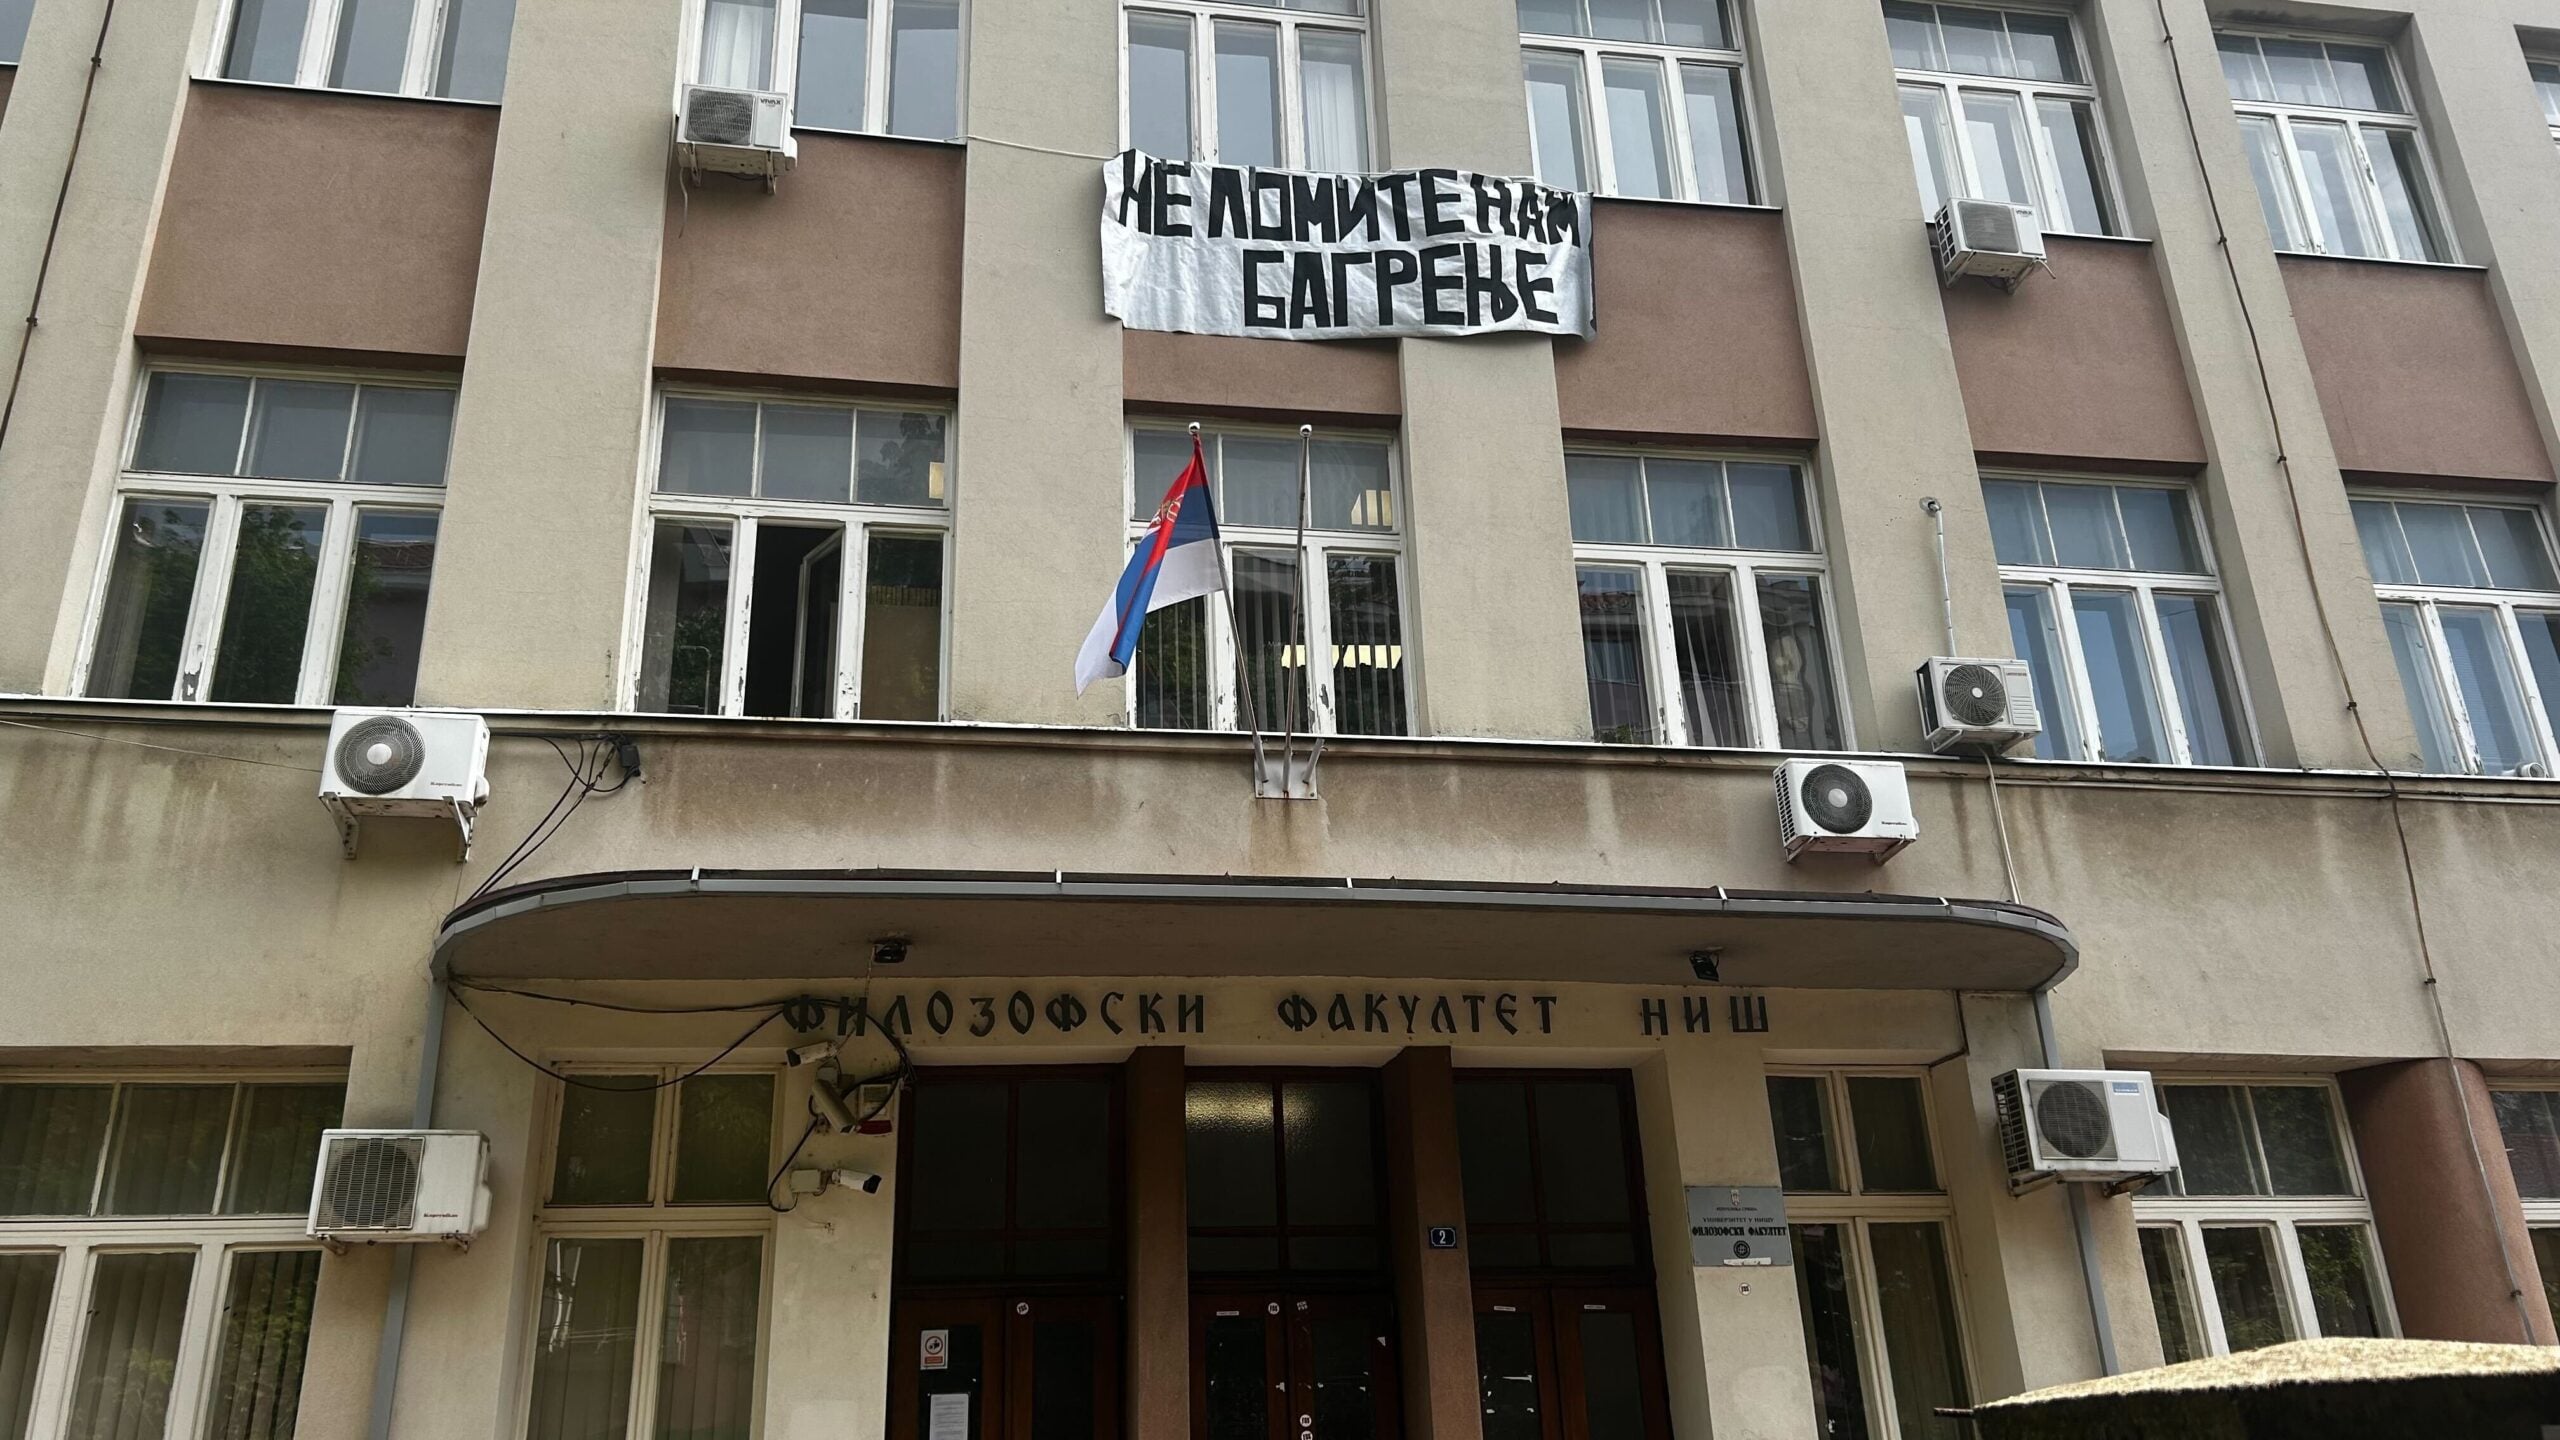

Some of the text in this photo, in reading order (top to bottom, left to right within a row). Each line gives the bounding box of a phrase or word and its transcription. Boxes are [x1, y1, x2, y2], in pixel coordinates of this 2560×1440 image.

[1119, 148, 1581, 248] НЕ ЛОМИТЕ НАМ
[1242, 242, 1559, 329] БАГРЕЊЕ
[782, 989, 1770, 1037] ФИЛОЗОФСКИ ФАКУЛТЕТ НИШ
[1438, 1229, 1447, 1245] 2
[1692, 1226, 1786, 1236] ФИЛОЗОФСКИ ФАКУЛТЕТ
